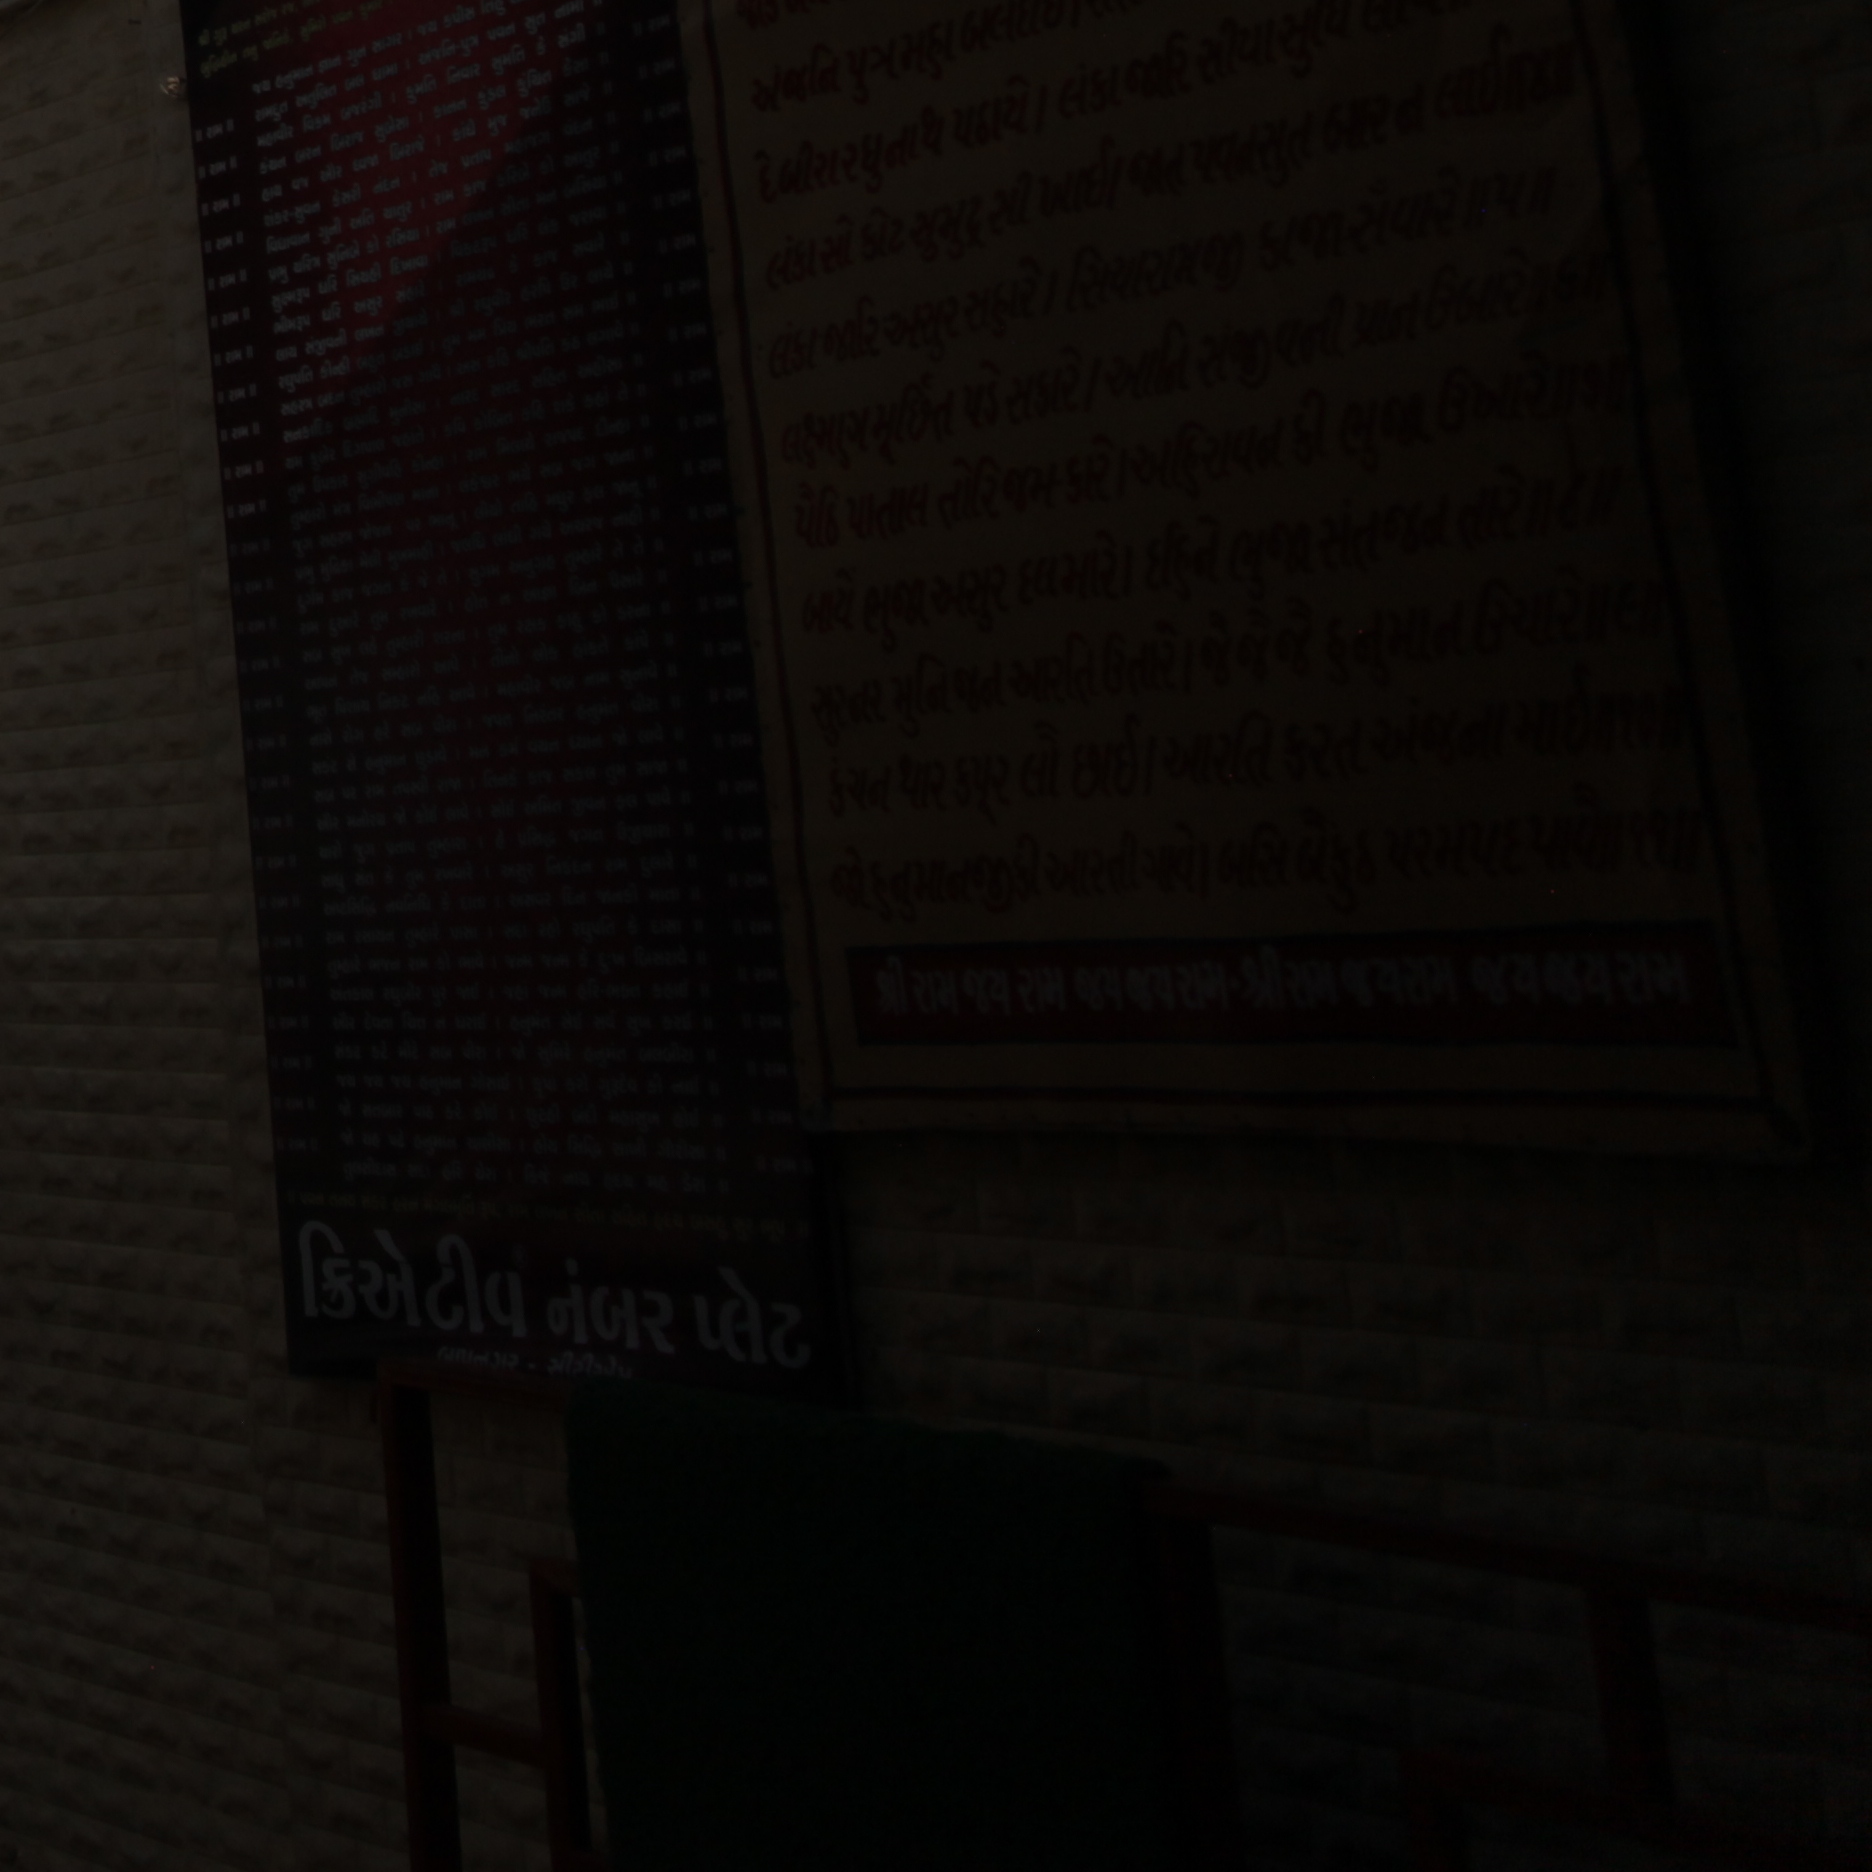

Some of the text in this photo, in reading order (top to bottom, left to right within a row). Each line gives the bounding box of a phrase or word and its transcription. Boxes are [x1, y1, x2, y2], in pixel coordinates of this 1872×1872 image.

[912, 970, 957, 1012] રામ
[962, 968, 1009, 1013] જય
[1017, 967, 1064, 1011] રામ
[547, 1258, 674, 1353] નંબર
[693, 1266, 810, 1367] પ્લેટ
